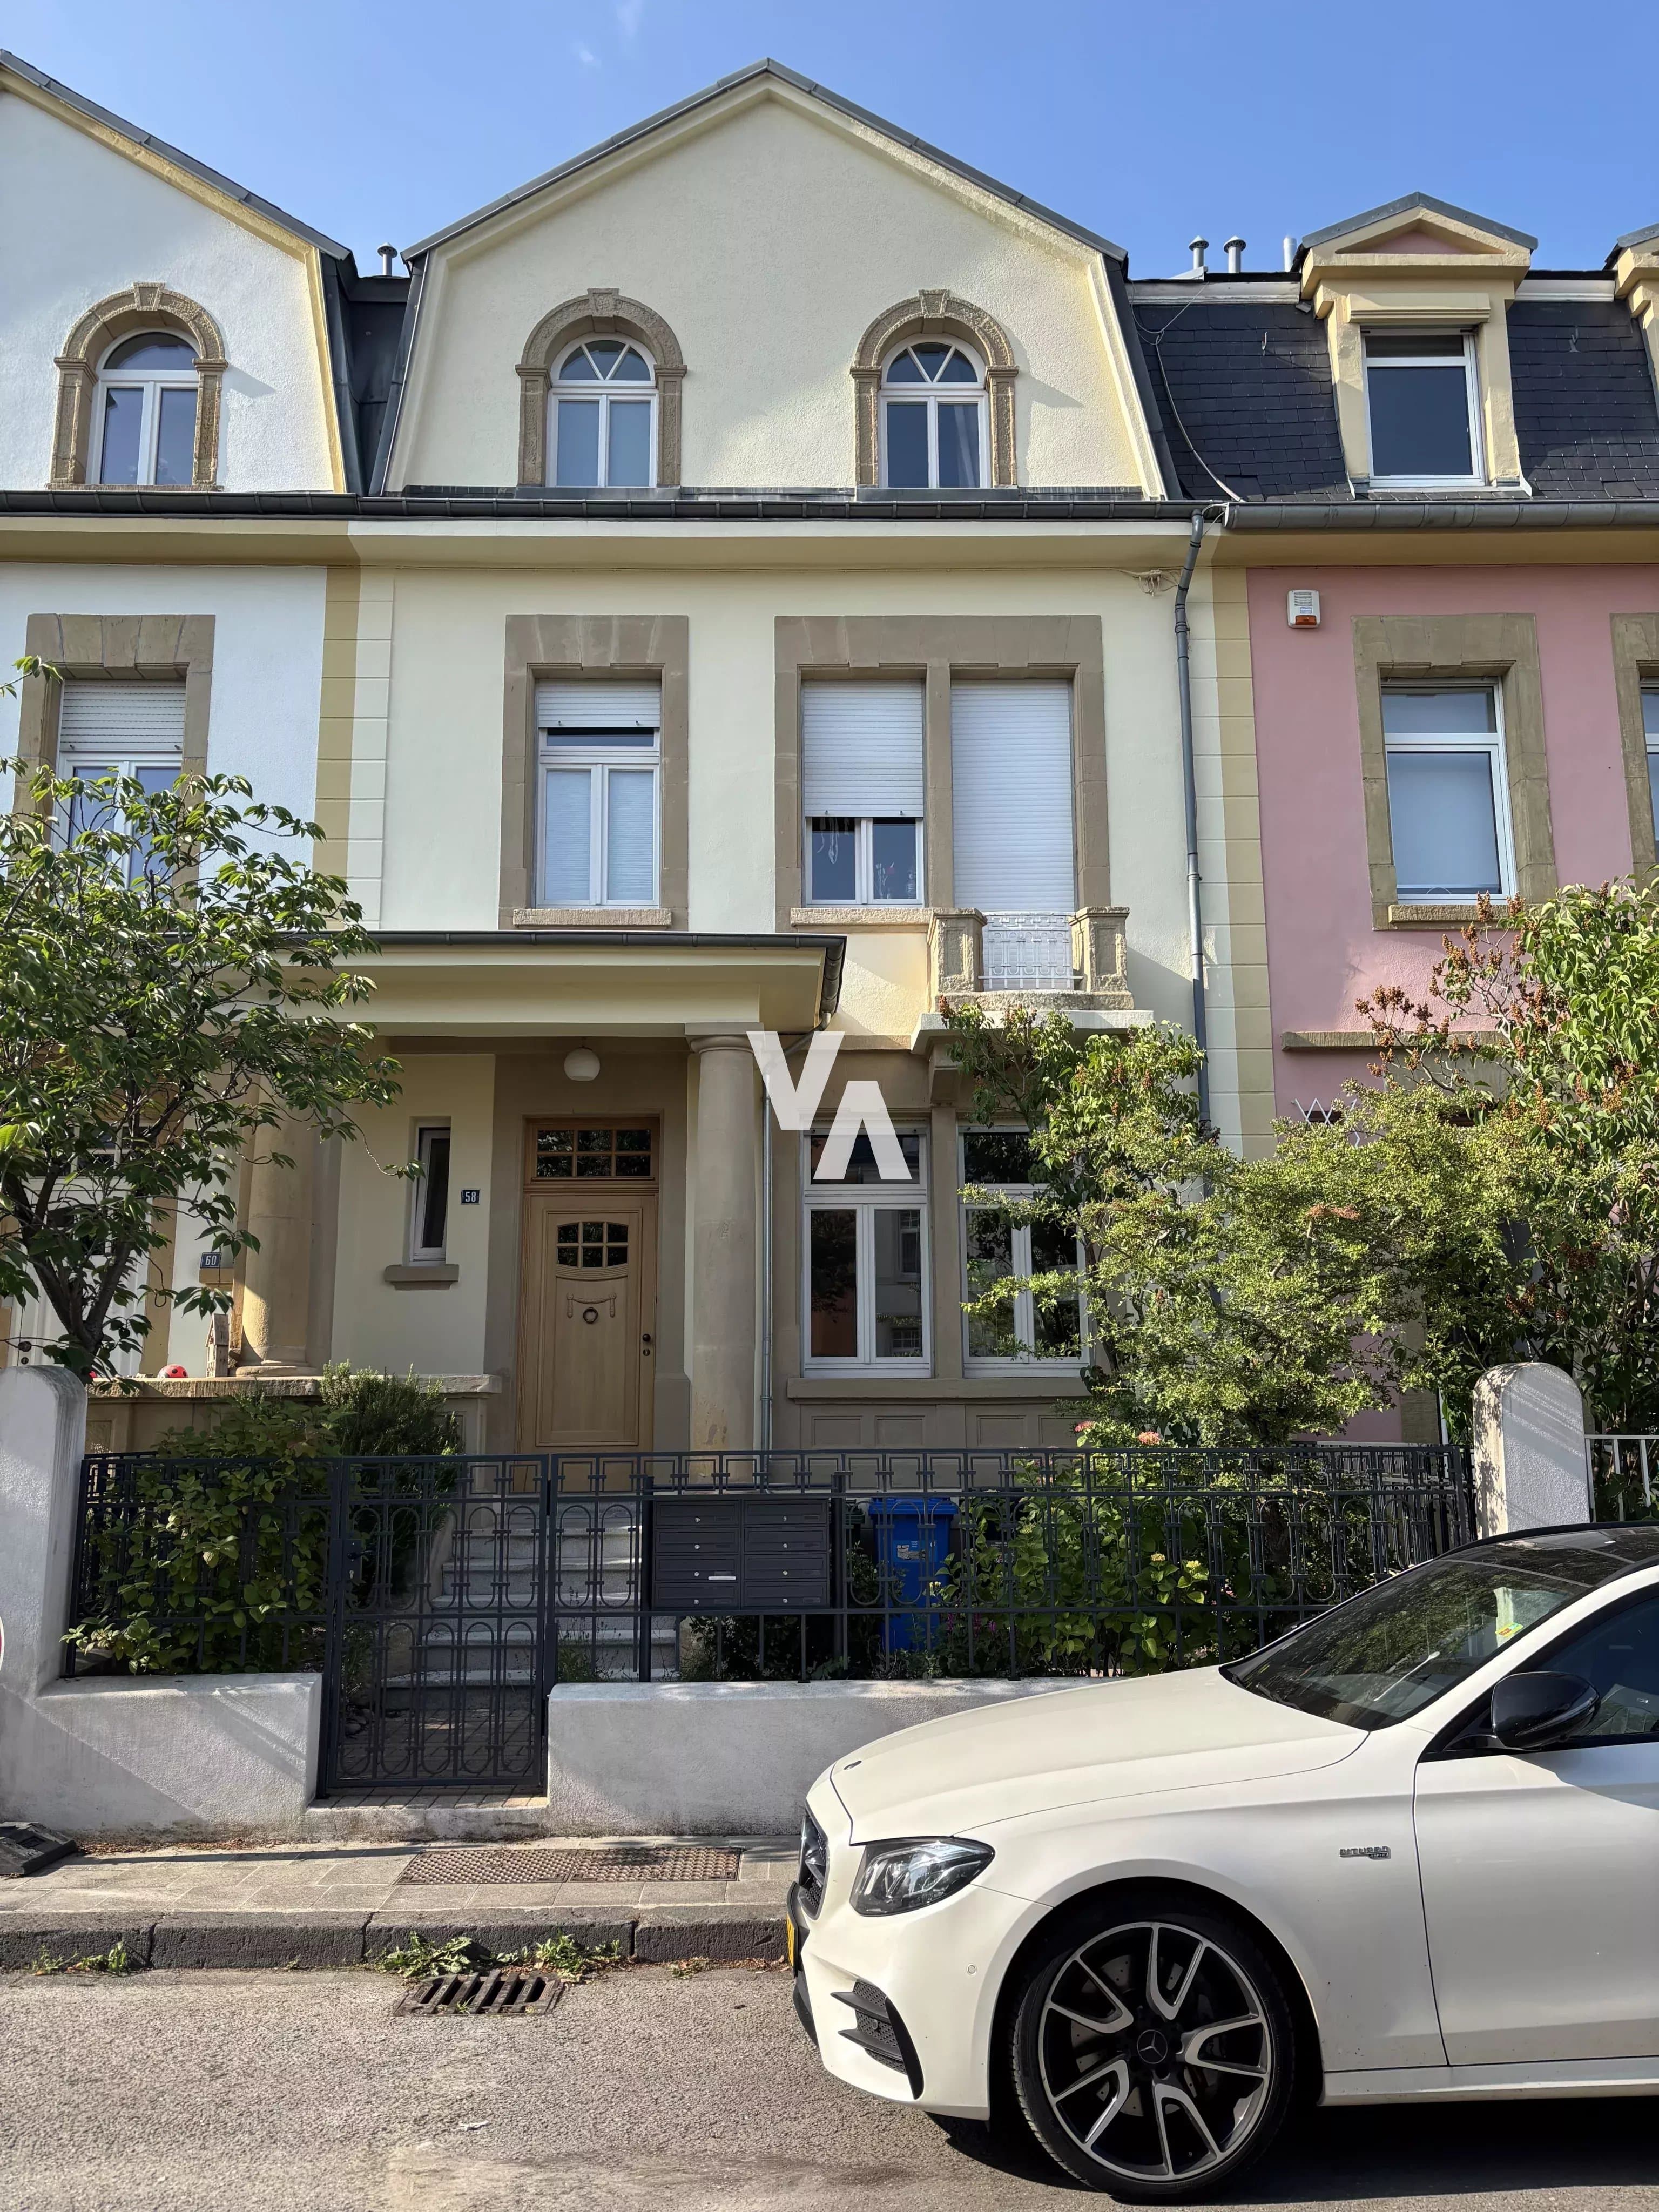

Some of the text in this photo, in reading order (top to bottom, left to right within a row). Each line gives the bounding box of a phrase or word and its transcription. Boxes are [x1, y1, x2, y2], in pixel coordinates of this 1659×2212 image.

[465, 1191, 476, 1202] 58
[205, 1255, 217, 1265] 60
[1339, 1846, 1388, 1855] BITURBO
